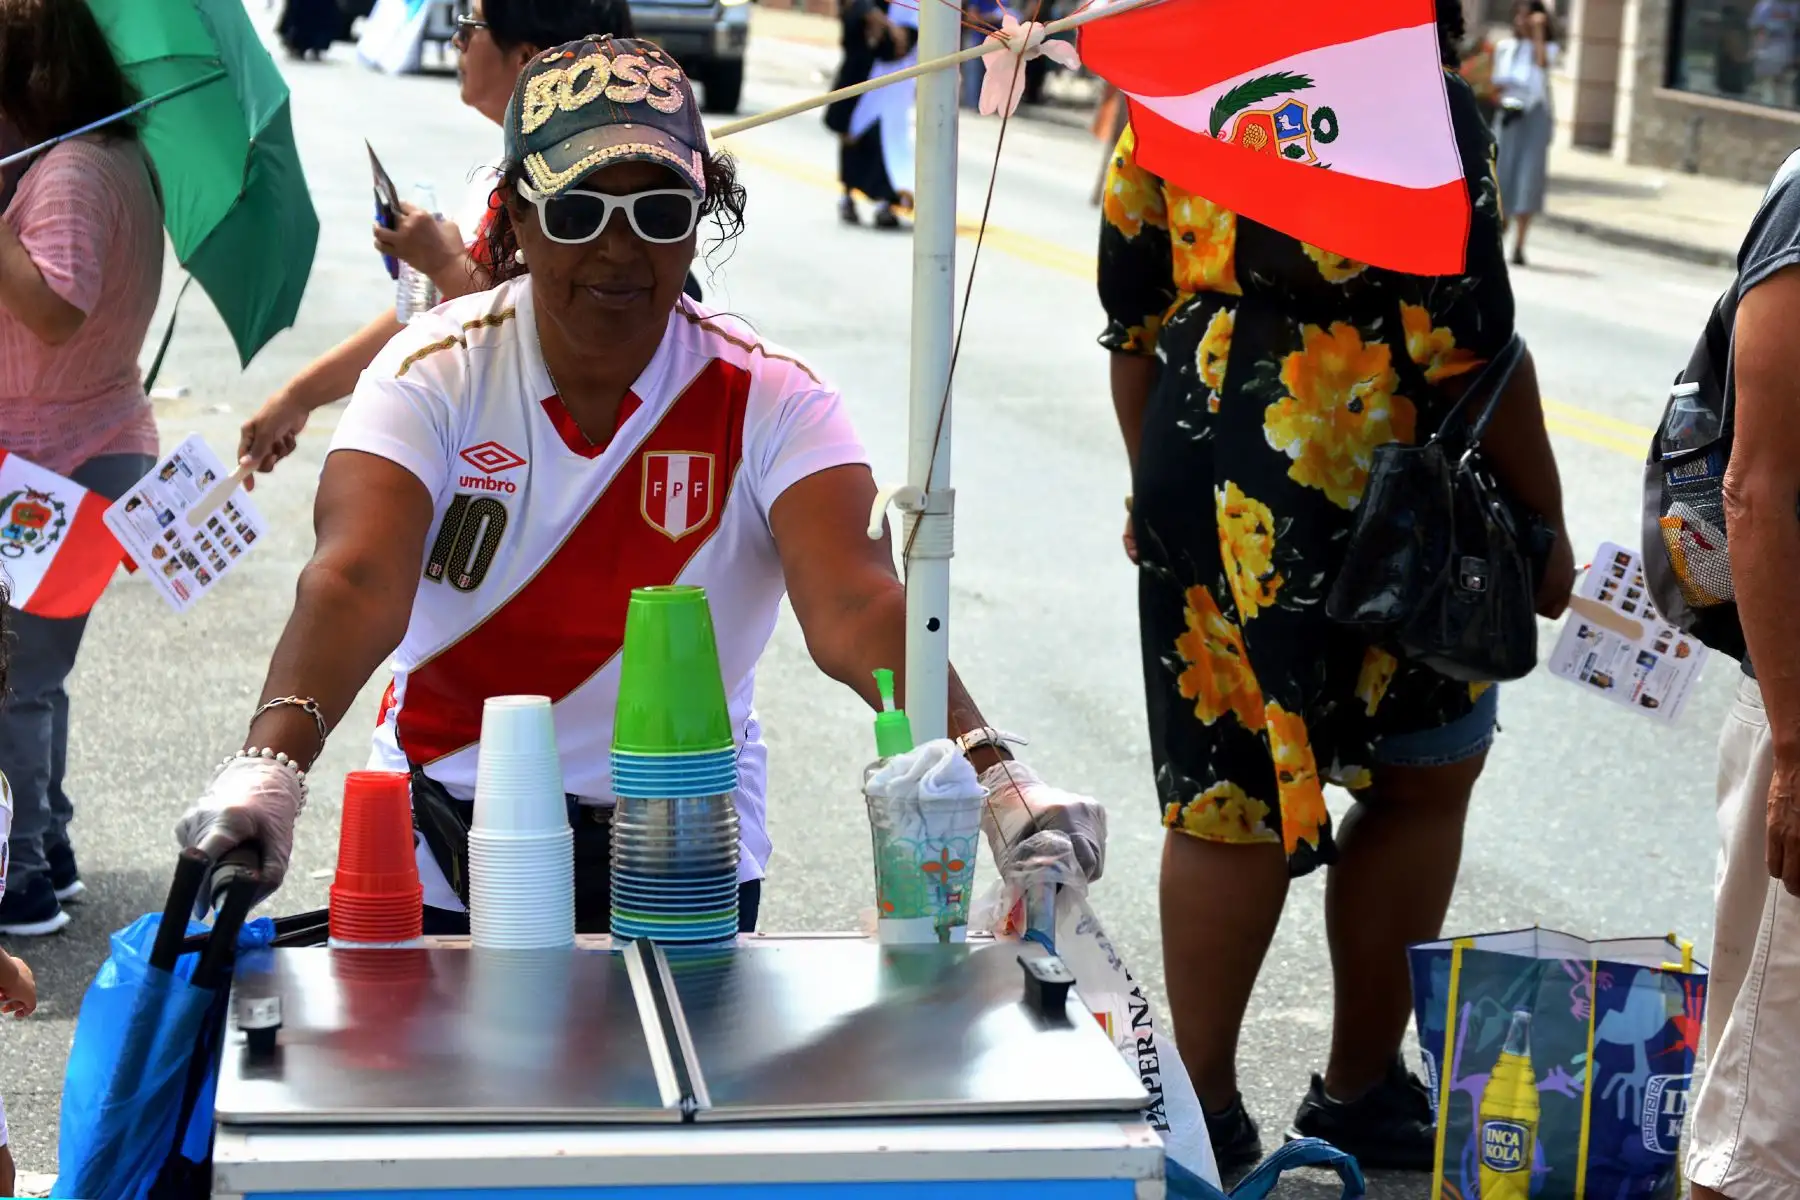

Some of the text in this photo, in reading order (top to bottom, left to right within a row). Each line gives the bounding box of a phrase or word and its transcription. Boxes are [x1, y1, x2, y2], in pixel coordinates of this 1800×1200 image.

[521, 53, 684, 134] BOSS
[459, 476, 517, 494] umbro
[423, 492, 508, 593] 10
[1136, 1033, 1172, 1134] PAPER
[1485, 1144, 1521, 1161] KOLA
[1486, 1128, 1520, 1146] INCA
